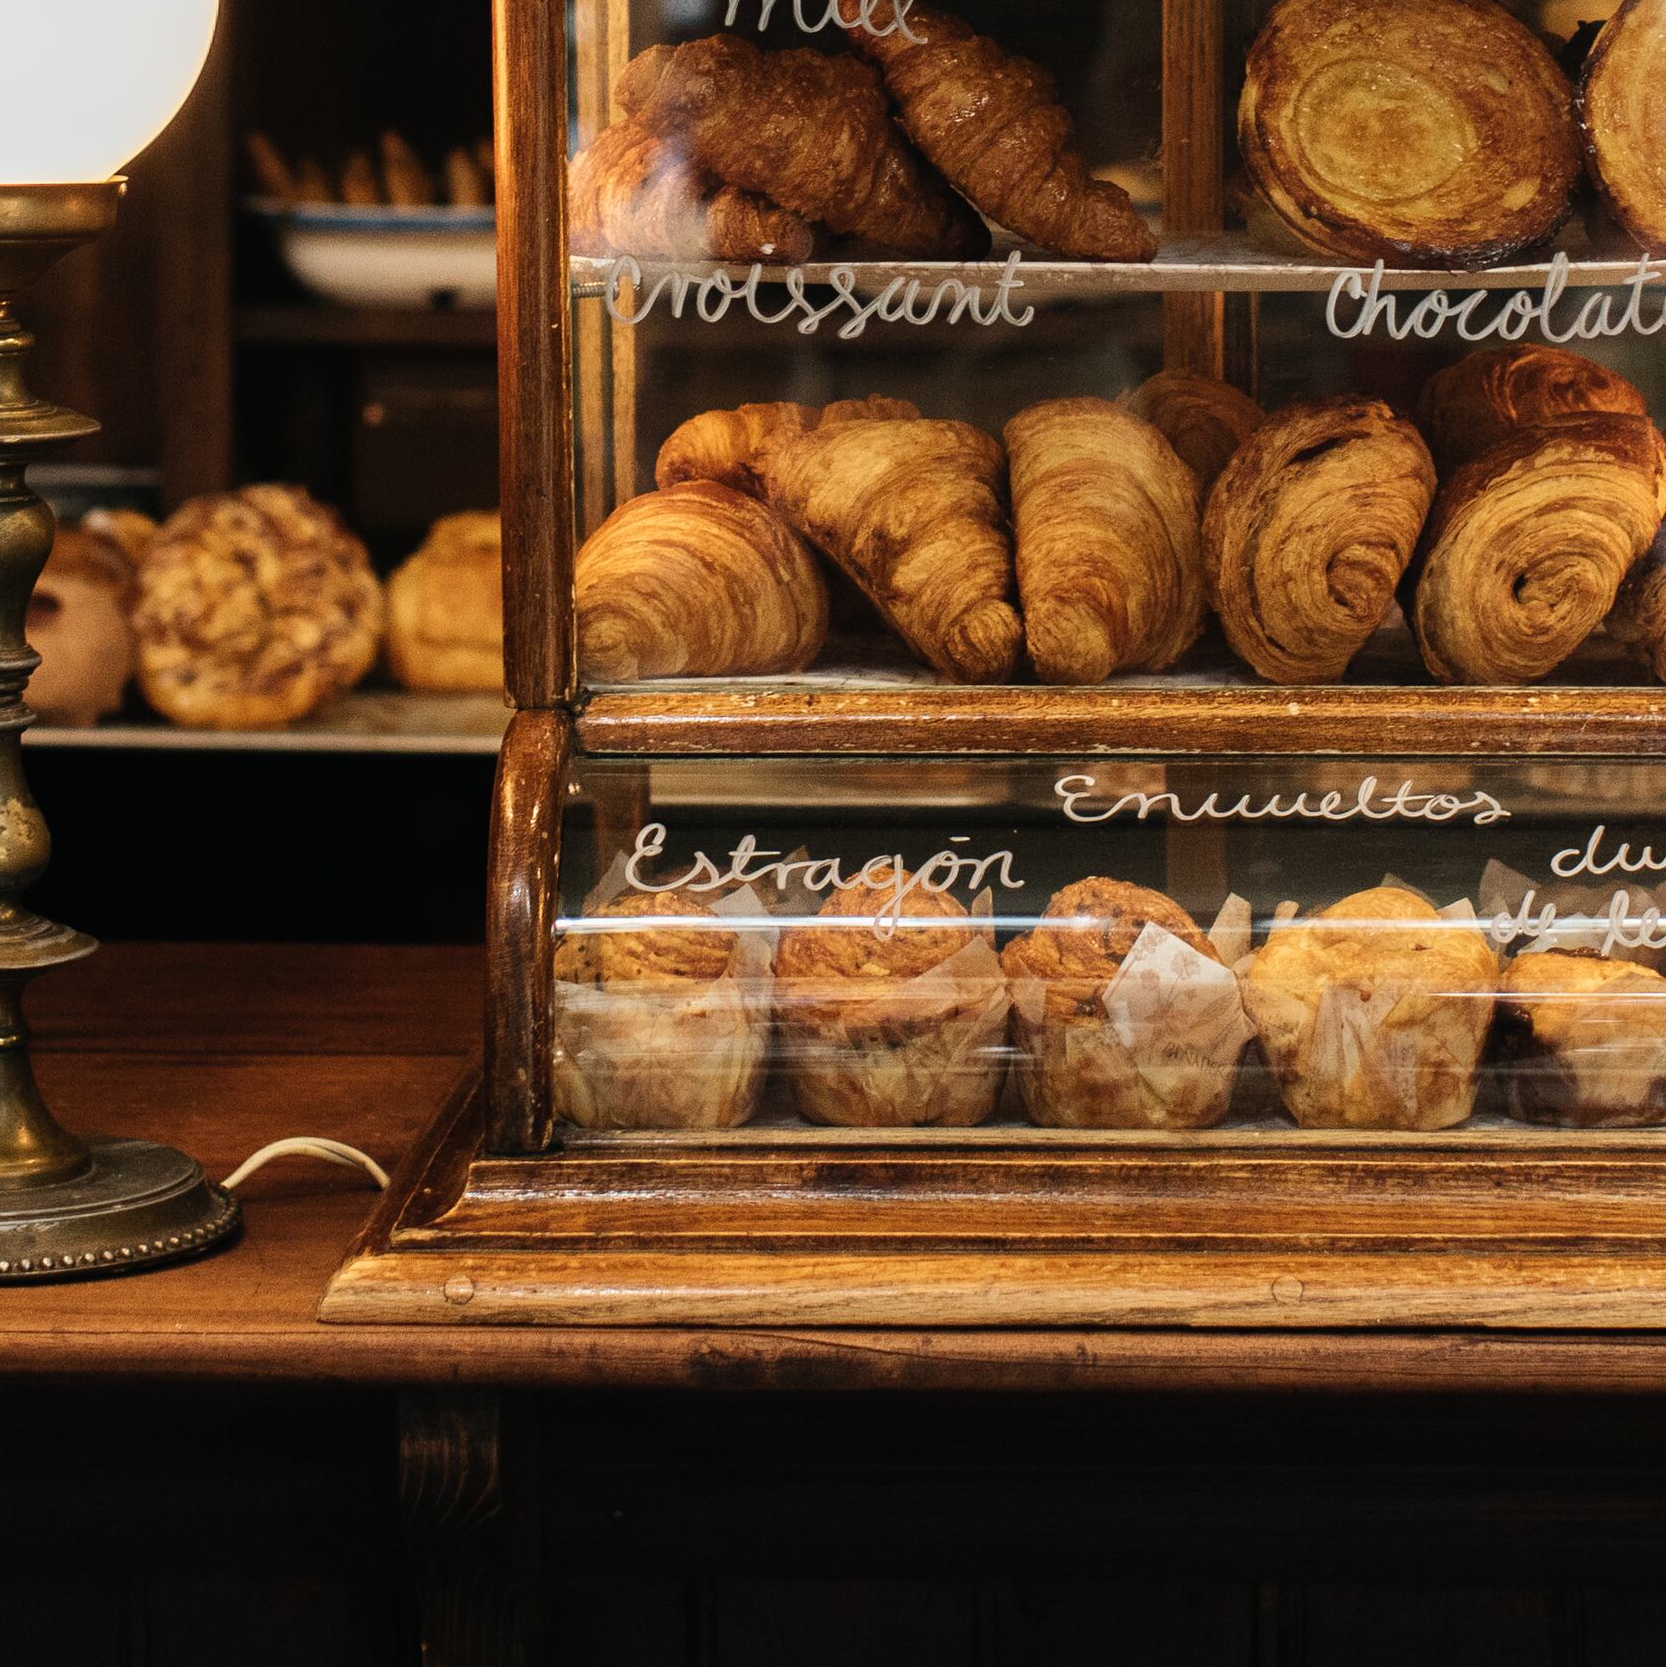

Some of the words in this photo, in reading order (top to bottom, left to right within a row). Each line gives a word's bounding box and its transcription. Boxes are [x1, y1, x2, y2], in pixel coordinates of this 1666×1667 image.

[604, 249, 1035, 340] Croissant
[624, 822, 1026, 940] Estragón
[1490, 889, 1558, 944] de
